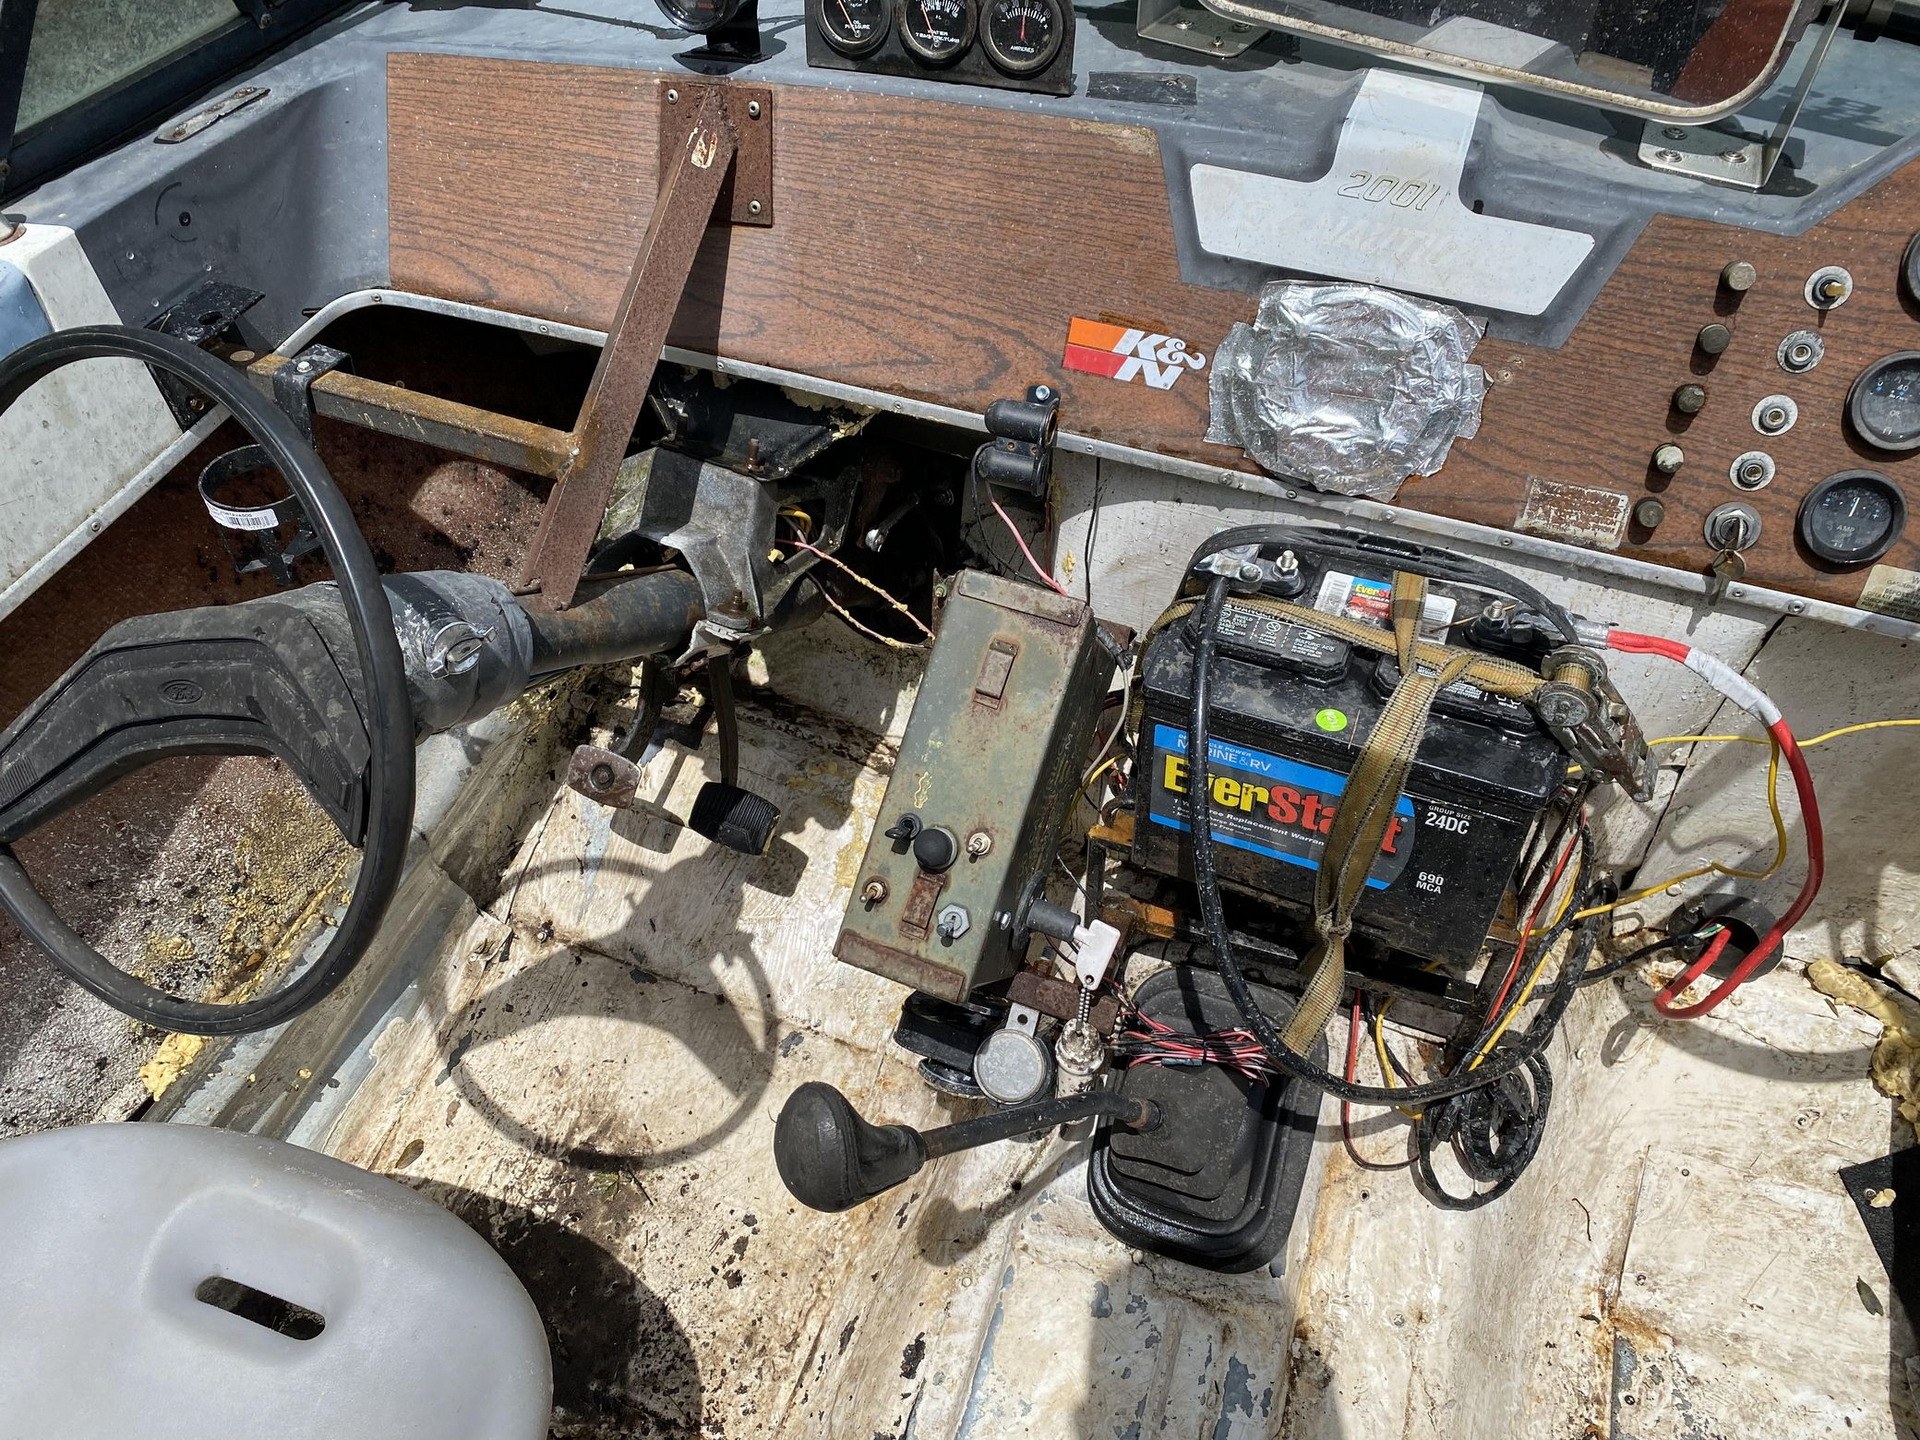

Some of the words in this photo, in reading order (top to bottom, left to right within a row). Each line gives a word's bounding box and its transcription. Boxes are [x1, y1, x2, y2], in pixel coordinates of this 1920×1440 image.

[1337, 170, 1441, 211] 2001
[1836, 524, 1856, 533] AMP
[1225, 745, 1252, 757] POWER
[1249, 758, 1272, 773] RV
[1428, 805, 1455, 815] GROUP
[1455, 811, 1472, 821] SIZE
[1226, 810, 1288, 837] Replacement
[1291, 831, 1325, 847] Warran
[1424, 811, 1470, 835] 24DC
[1418, 871, 1445, 886] 690
[1415, 880, 1442, 894] MCA
